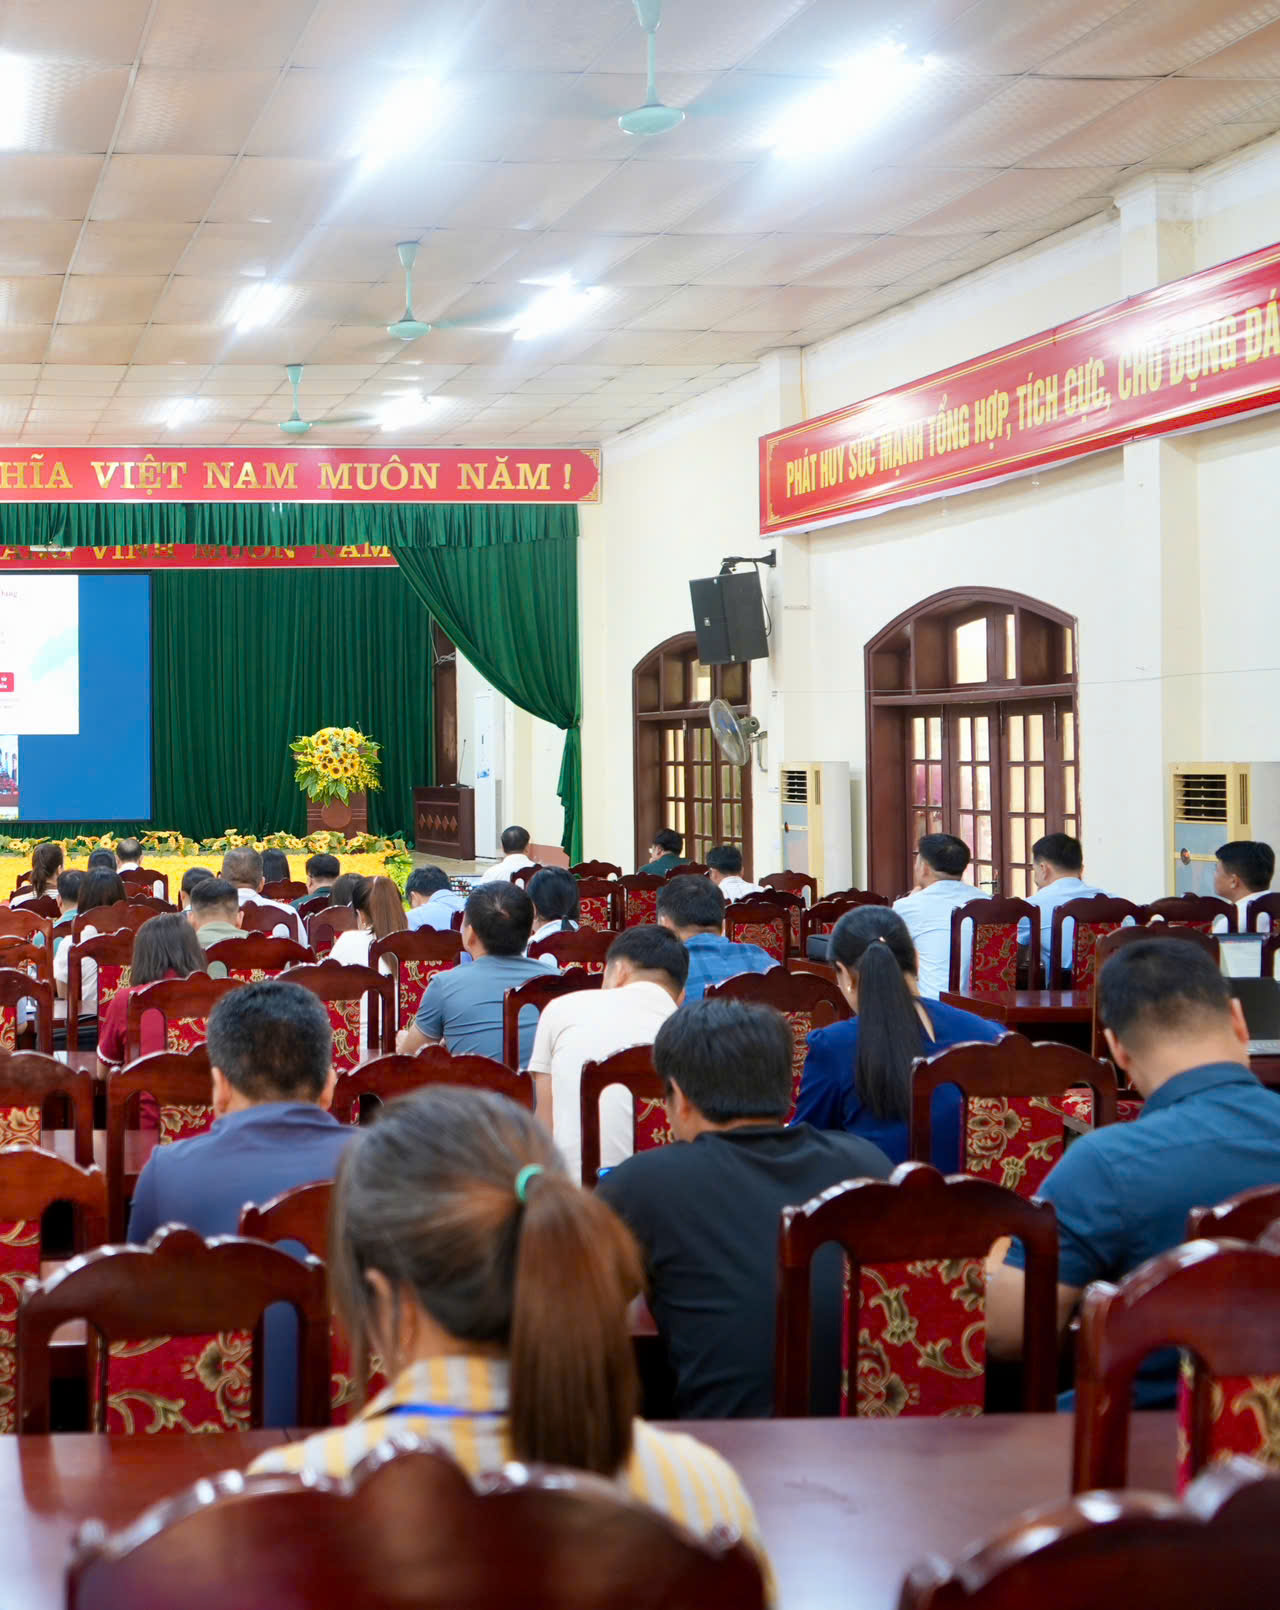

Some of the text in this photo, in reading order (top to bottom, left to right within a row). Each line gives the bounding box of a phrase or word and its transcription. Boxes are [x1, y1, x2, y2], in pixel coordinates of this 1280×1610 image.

[90, 454, 188, 495] VIỆT
[203, 461, 299, 490] NAM
[317, 454, 440, 490] MUÔN
[457, 455, 552, 490] NĂM
[563, 463, 572, 490] !
[786, 447, 818, 499] PHÁT
[820, 444, 846, 489] HUY
[880, 420, 924, 477] MẠNH
[927, 393, 970, 457] TỔNG
[974, 389, 1012, 450] HỢP,
[1016, 372, 1059, 431] TÍCH
